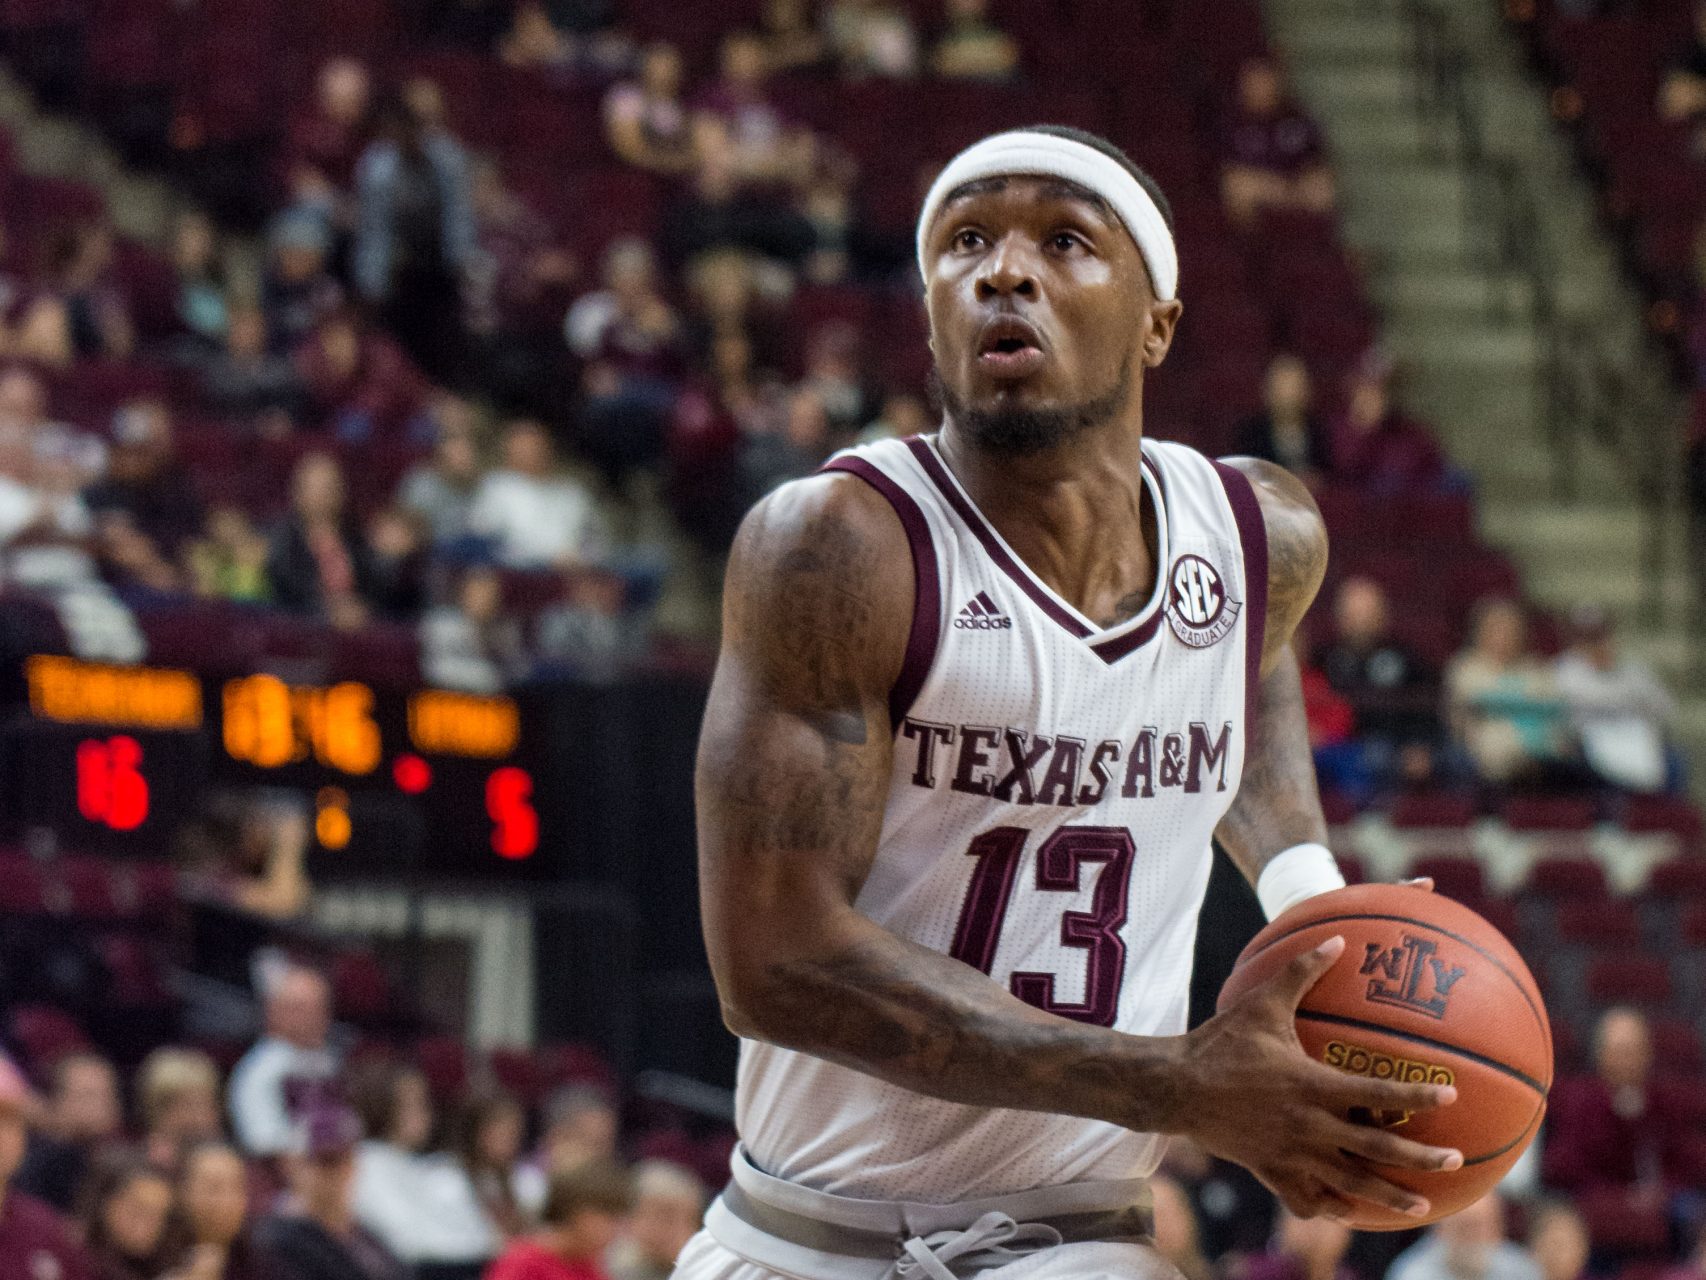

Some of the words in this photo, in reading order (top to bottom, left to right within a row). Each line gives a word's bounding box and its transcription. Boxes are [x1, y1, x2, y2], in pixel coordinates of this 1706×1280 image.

[953, 614, 1012, 630] adidas
[1174, 559, 1221, 624] SEC
[1174, 614, 1233, 646] GRADUATE
[903, 717, 1122, 807] TEXAS
[1121, 720, 1233, 798] A&M
[949, 826, 1137, 1029] 13
